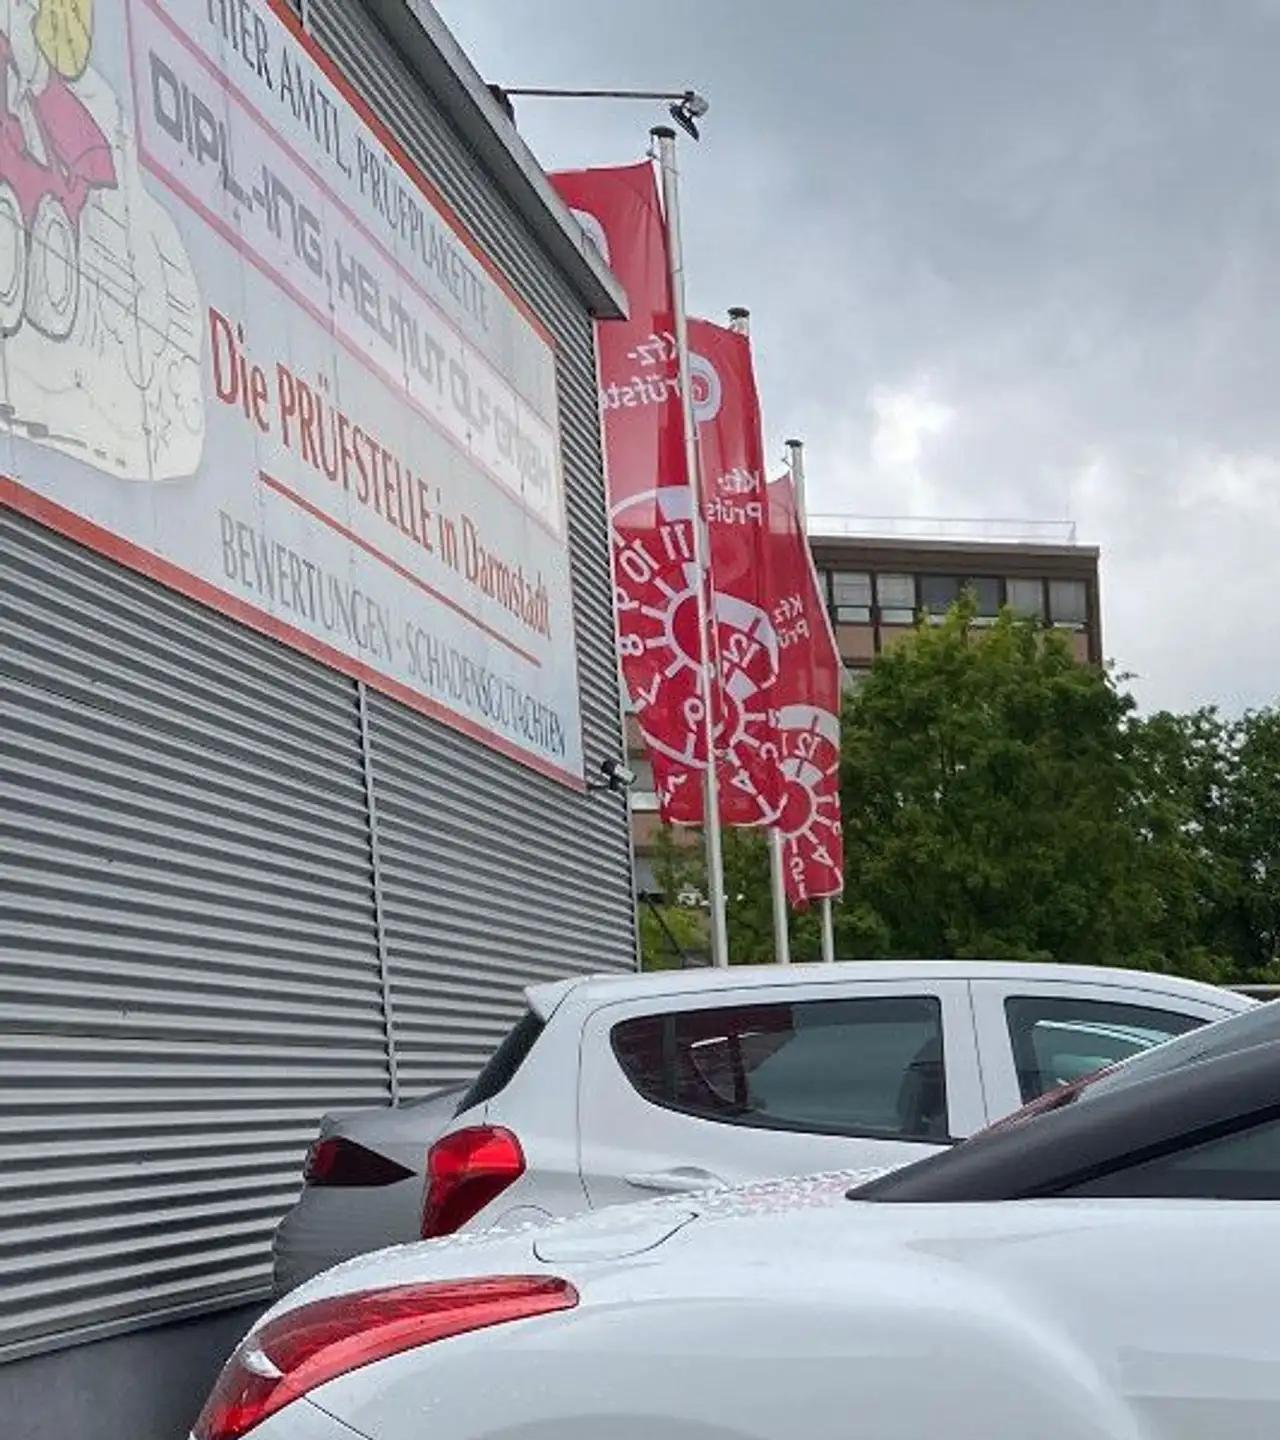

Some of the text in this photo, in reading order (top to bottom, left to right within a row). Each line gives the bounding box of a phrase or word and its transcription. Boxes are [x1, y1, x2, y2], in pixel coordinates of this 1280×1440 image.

[281, 47, 351, 180] AMTL.
[357, 136, 489, 331] PRÜFPLAKETTE
[209, 305, 551, 640] Die PRÜFSTELLE in Darmstadt
[219, 508, 393, 663] BEWERTUNGEN
